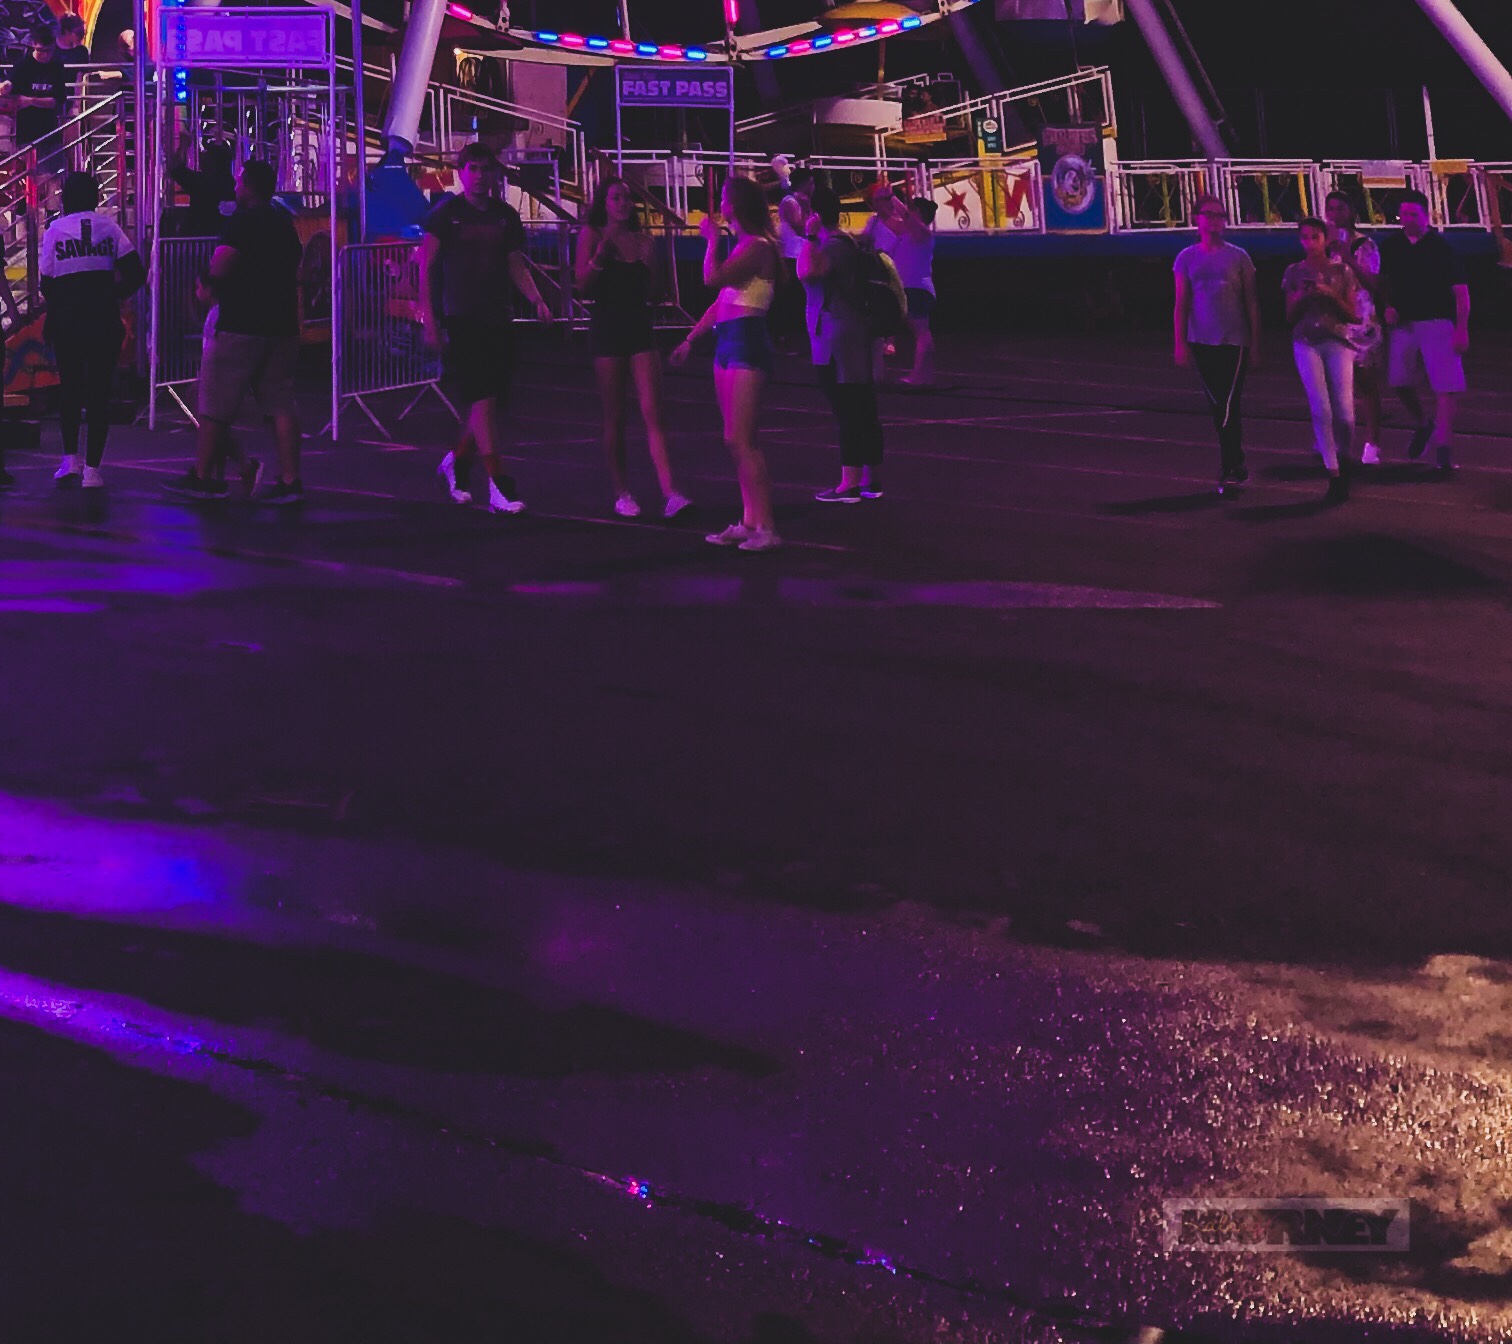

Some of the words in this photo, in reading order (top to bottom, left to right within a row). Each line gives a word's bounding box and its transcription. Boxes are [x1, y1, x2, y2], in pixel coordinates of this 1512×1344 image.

[622, 80, 671, 96] FAST
[675, 81, 728, 98] PASS
[55, 236, 115, 261] SAVAGE
